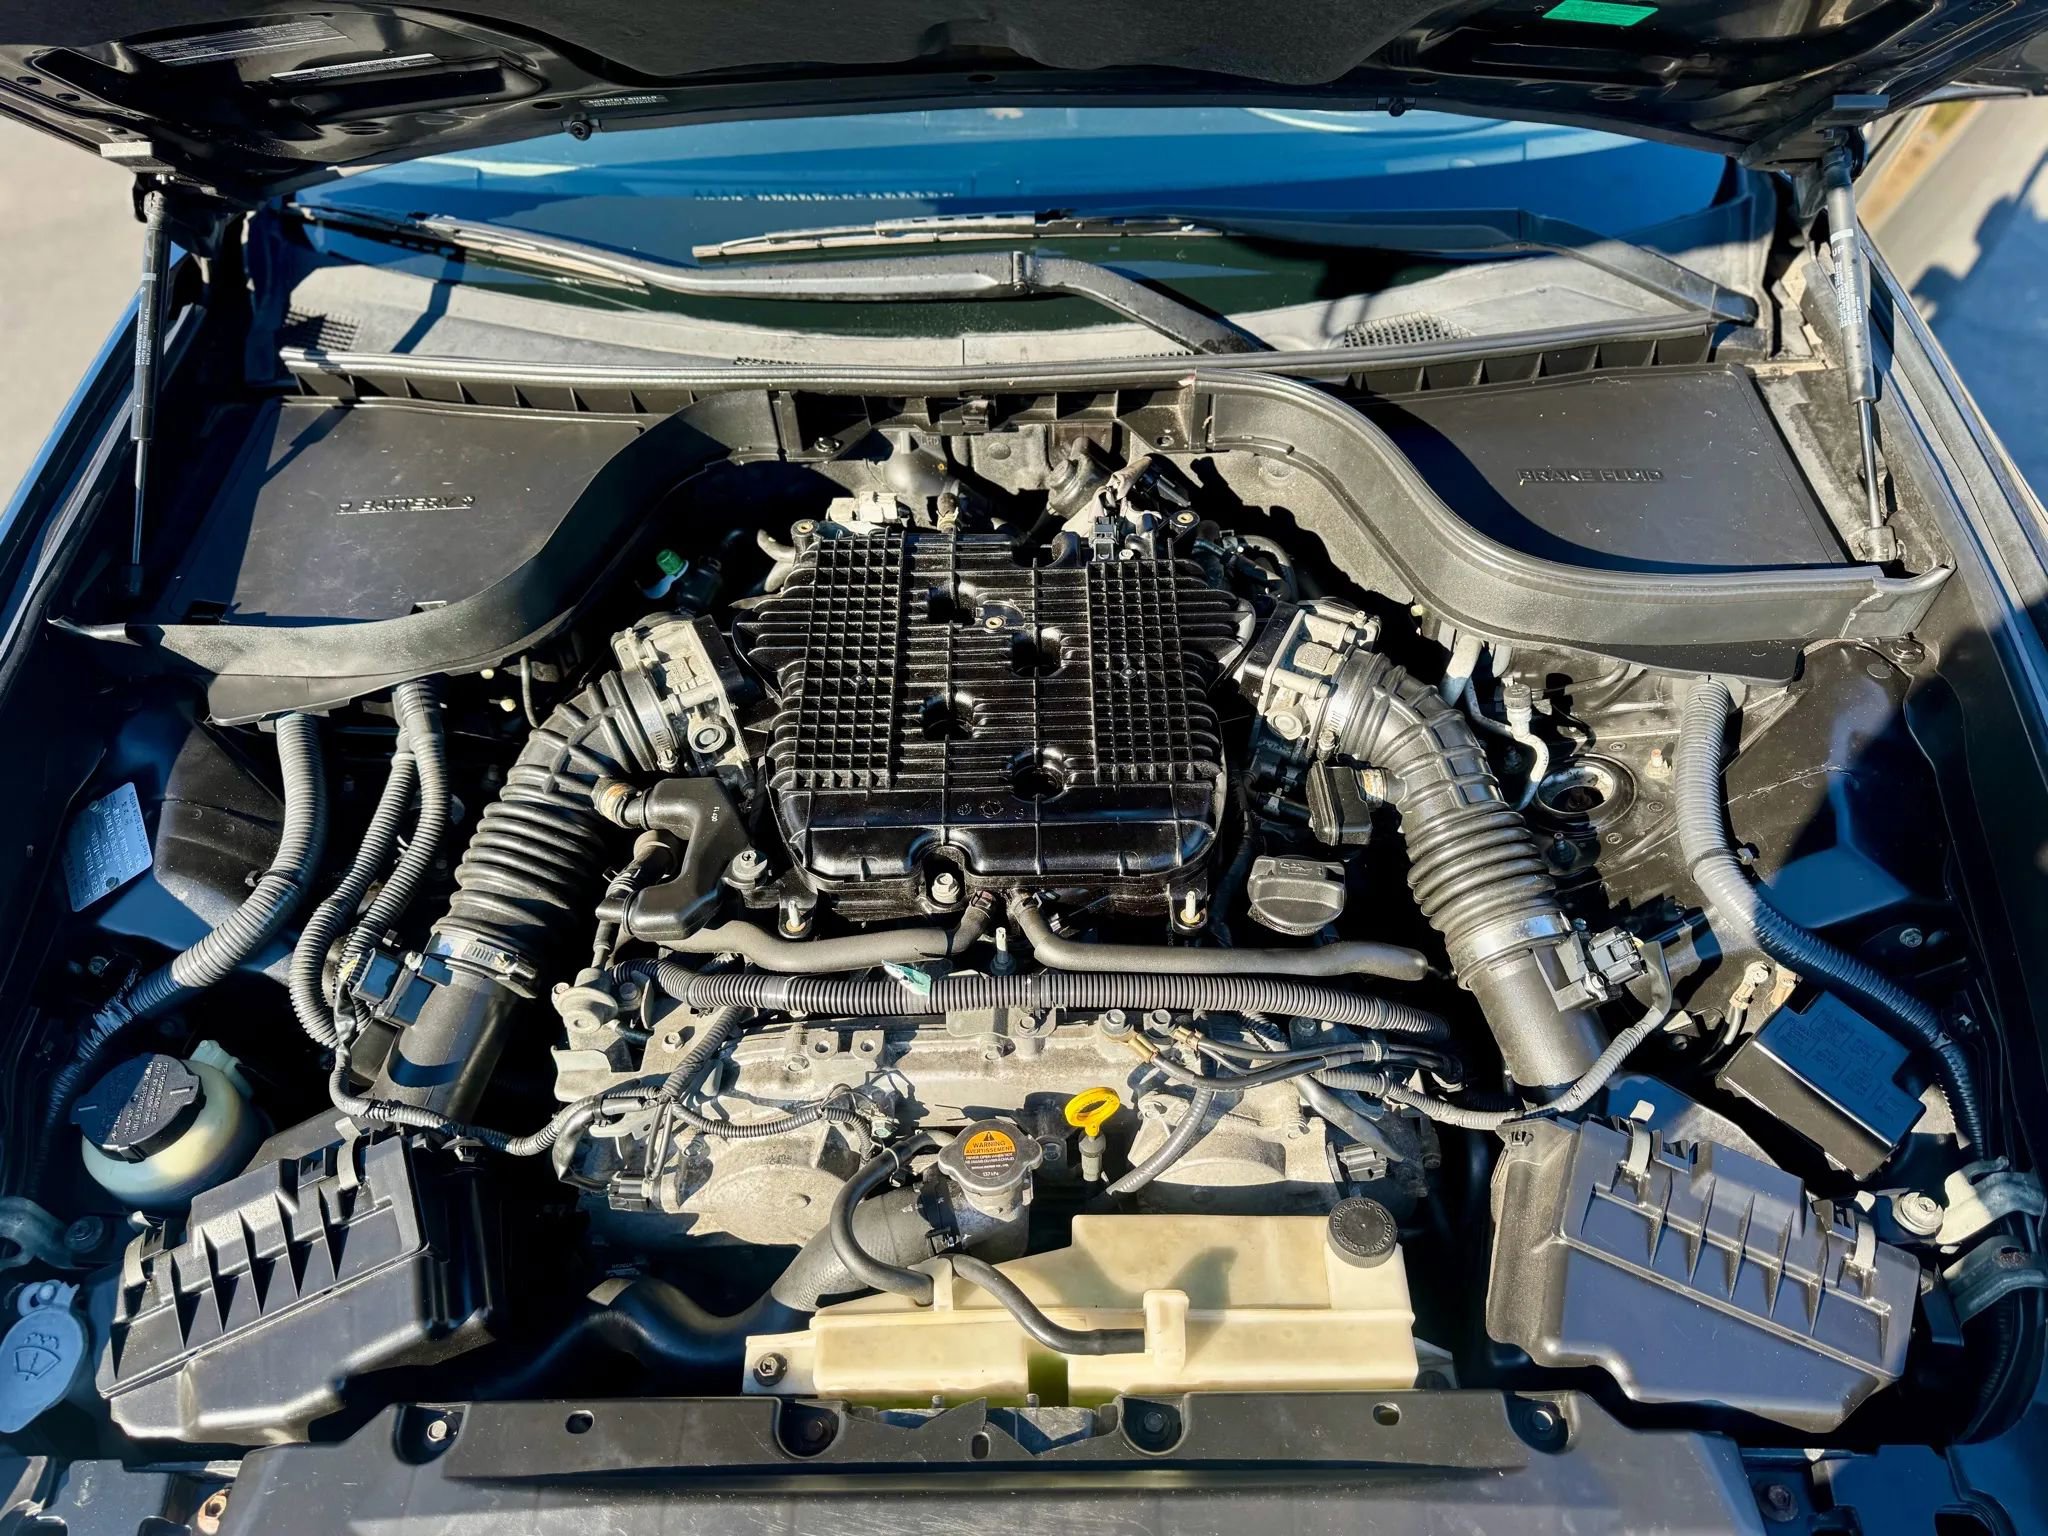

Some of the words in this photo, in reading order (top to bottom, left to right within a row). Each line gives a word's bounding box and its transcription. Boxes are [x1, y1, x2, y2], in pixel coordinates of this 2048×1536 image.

[1516, 470, 1596, 482] BRAKE
[1599, 470, 1664, 482] FLUID
[358, 496, 456, 513] BATTERY
[966, 1146, 1013, 1154] AVERTISSEMENT
